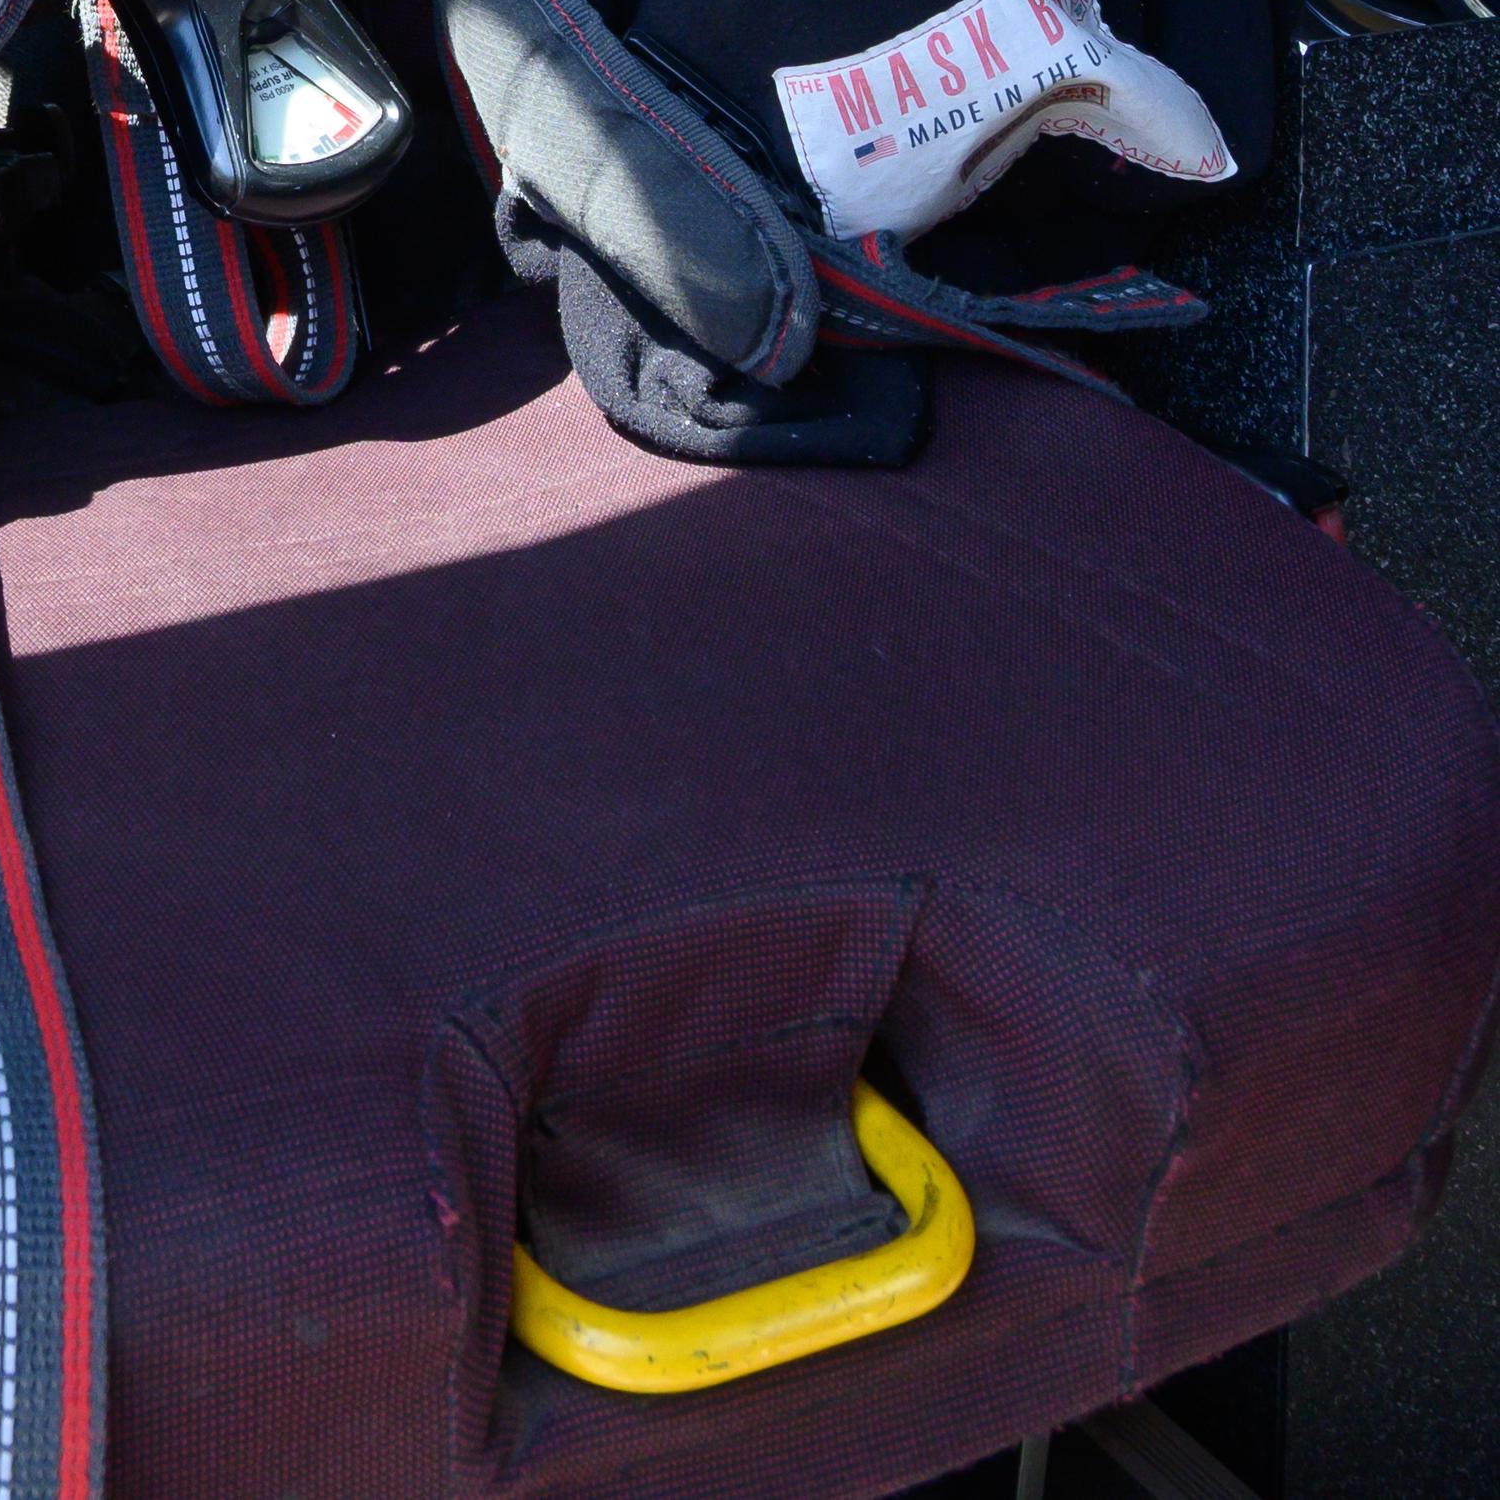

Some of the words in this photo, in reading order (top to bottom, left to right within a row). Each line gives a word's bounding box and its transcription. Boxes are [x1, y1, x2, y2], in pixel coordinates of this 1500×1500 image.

[259, 90, 275, 102] PSI
[275, 84, 294, 96] 4500
[788, 77, 825, 97] THE
[827, 7, 1010, 137] MASK
[908, 100, 985, 149] MADE
[994, 83, 1022, 111] IN
[1032, 54, 1082, 93] THE
